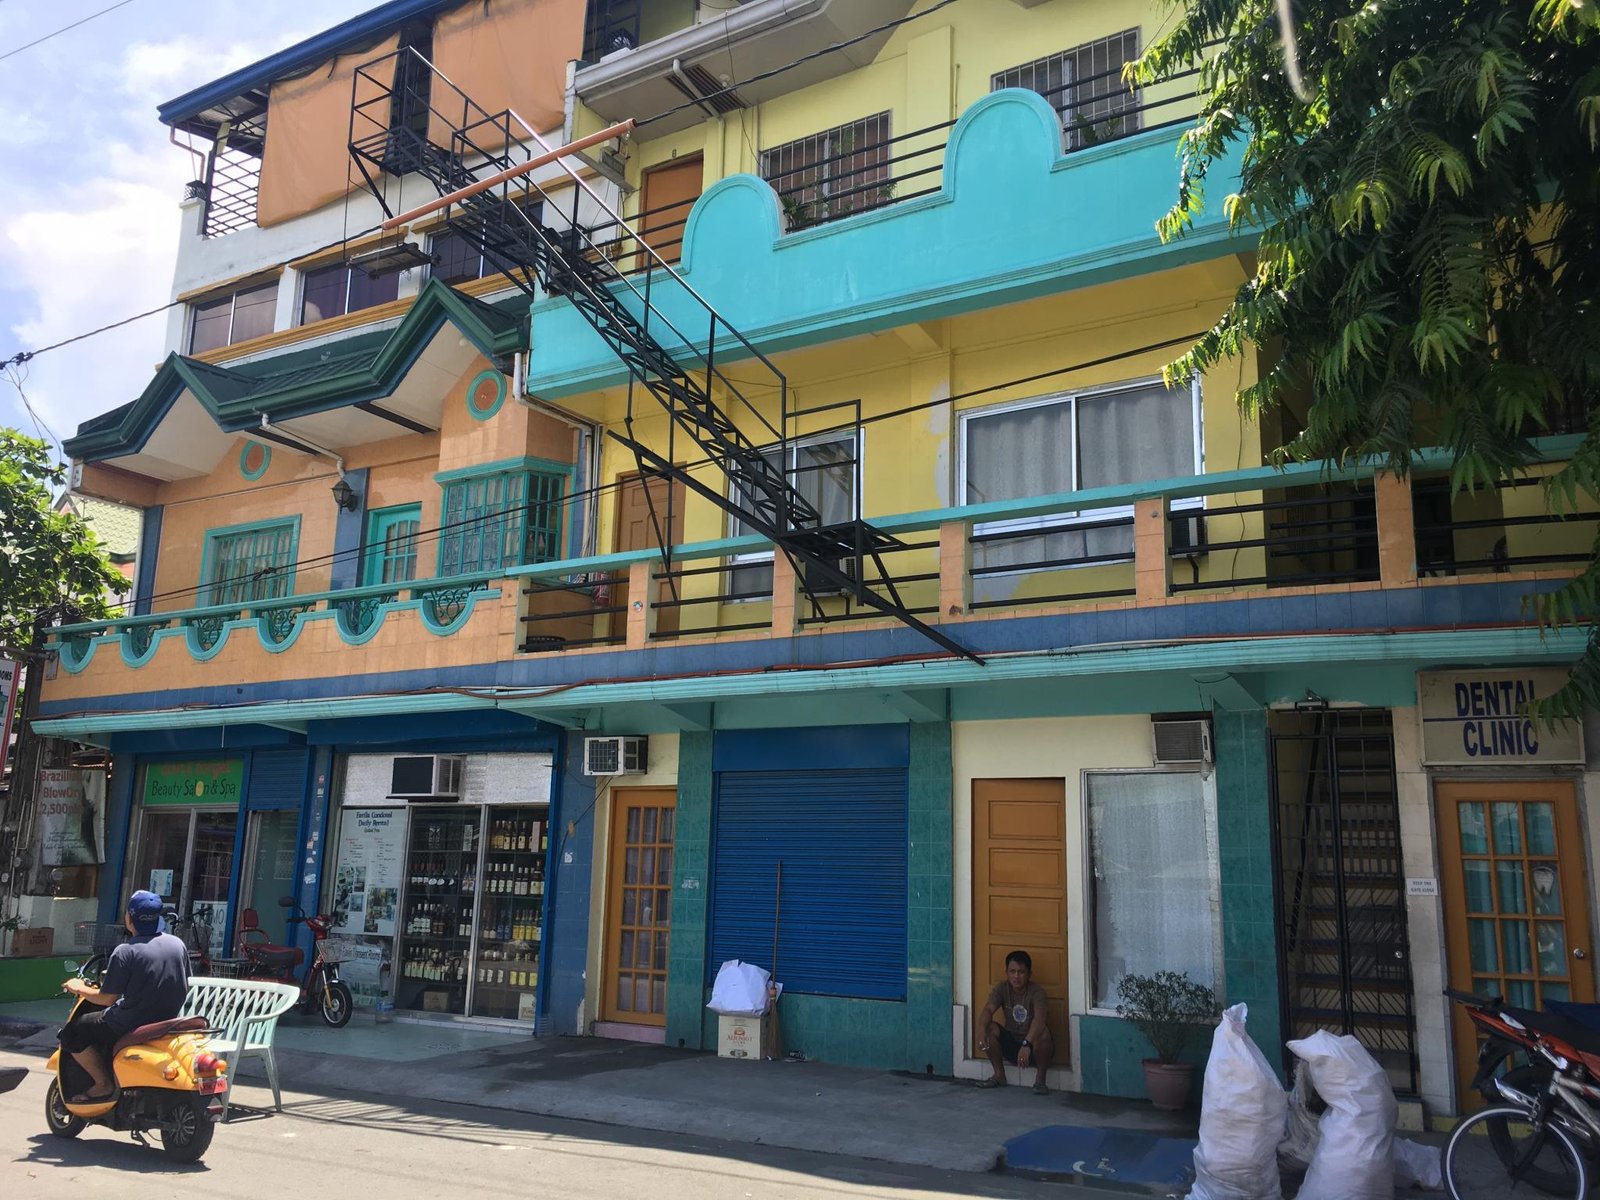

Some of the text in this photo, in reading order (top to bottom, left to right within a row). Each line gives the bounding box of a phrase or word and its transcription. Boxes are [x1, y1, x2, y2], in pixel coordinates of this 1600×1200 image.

[1463, 720, 1539, 756] CLINIC
[151, 780, 182, 798] Beauty
[211, 780, 218, 795] &
[220, 779, 236, 799] Spa
[358, 819, 390, 828] Daily Rental
